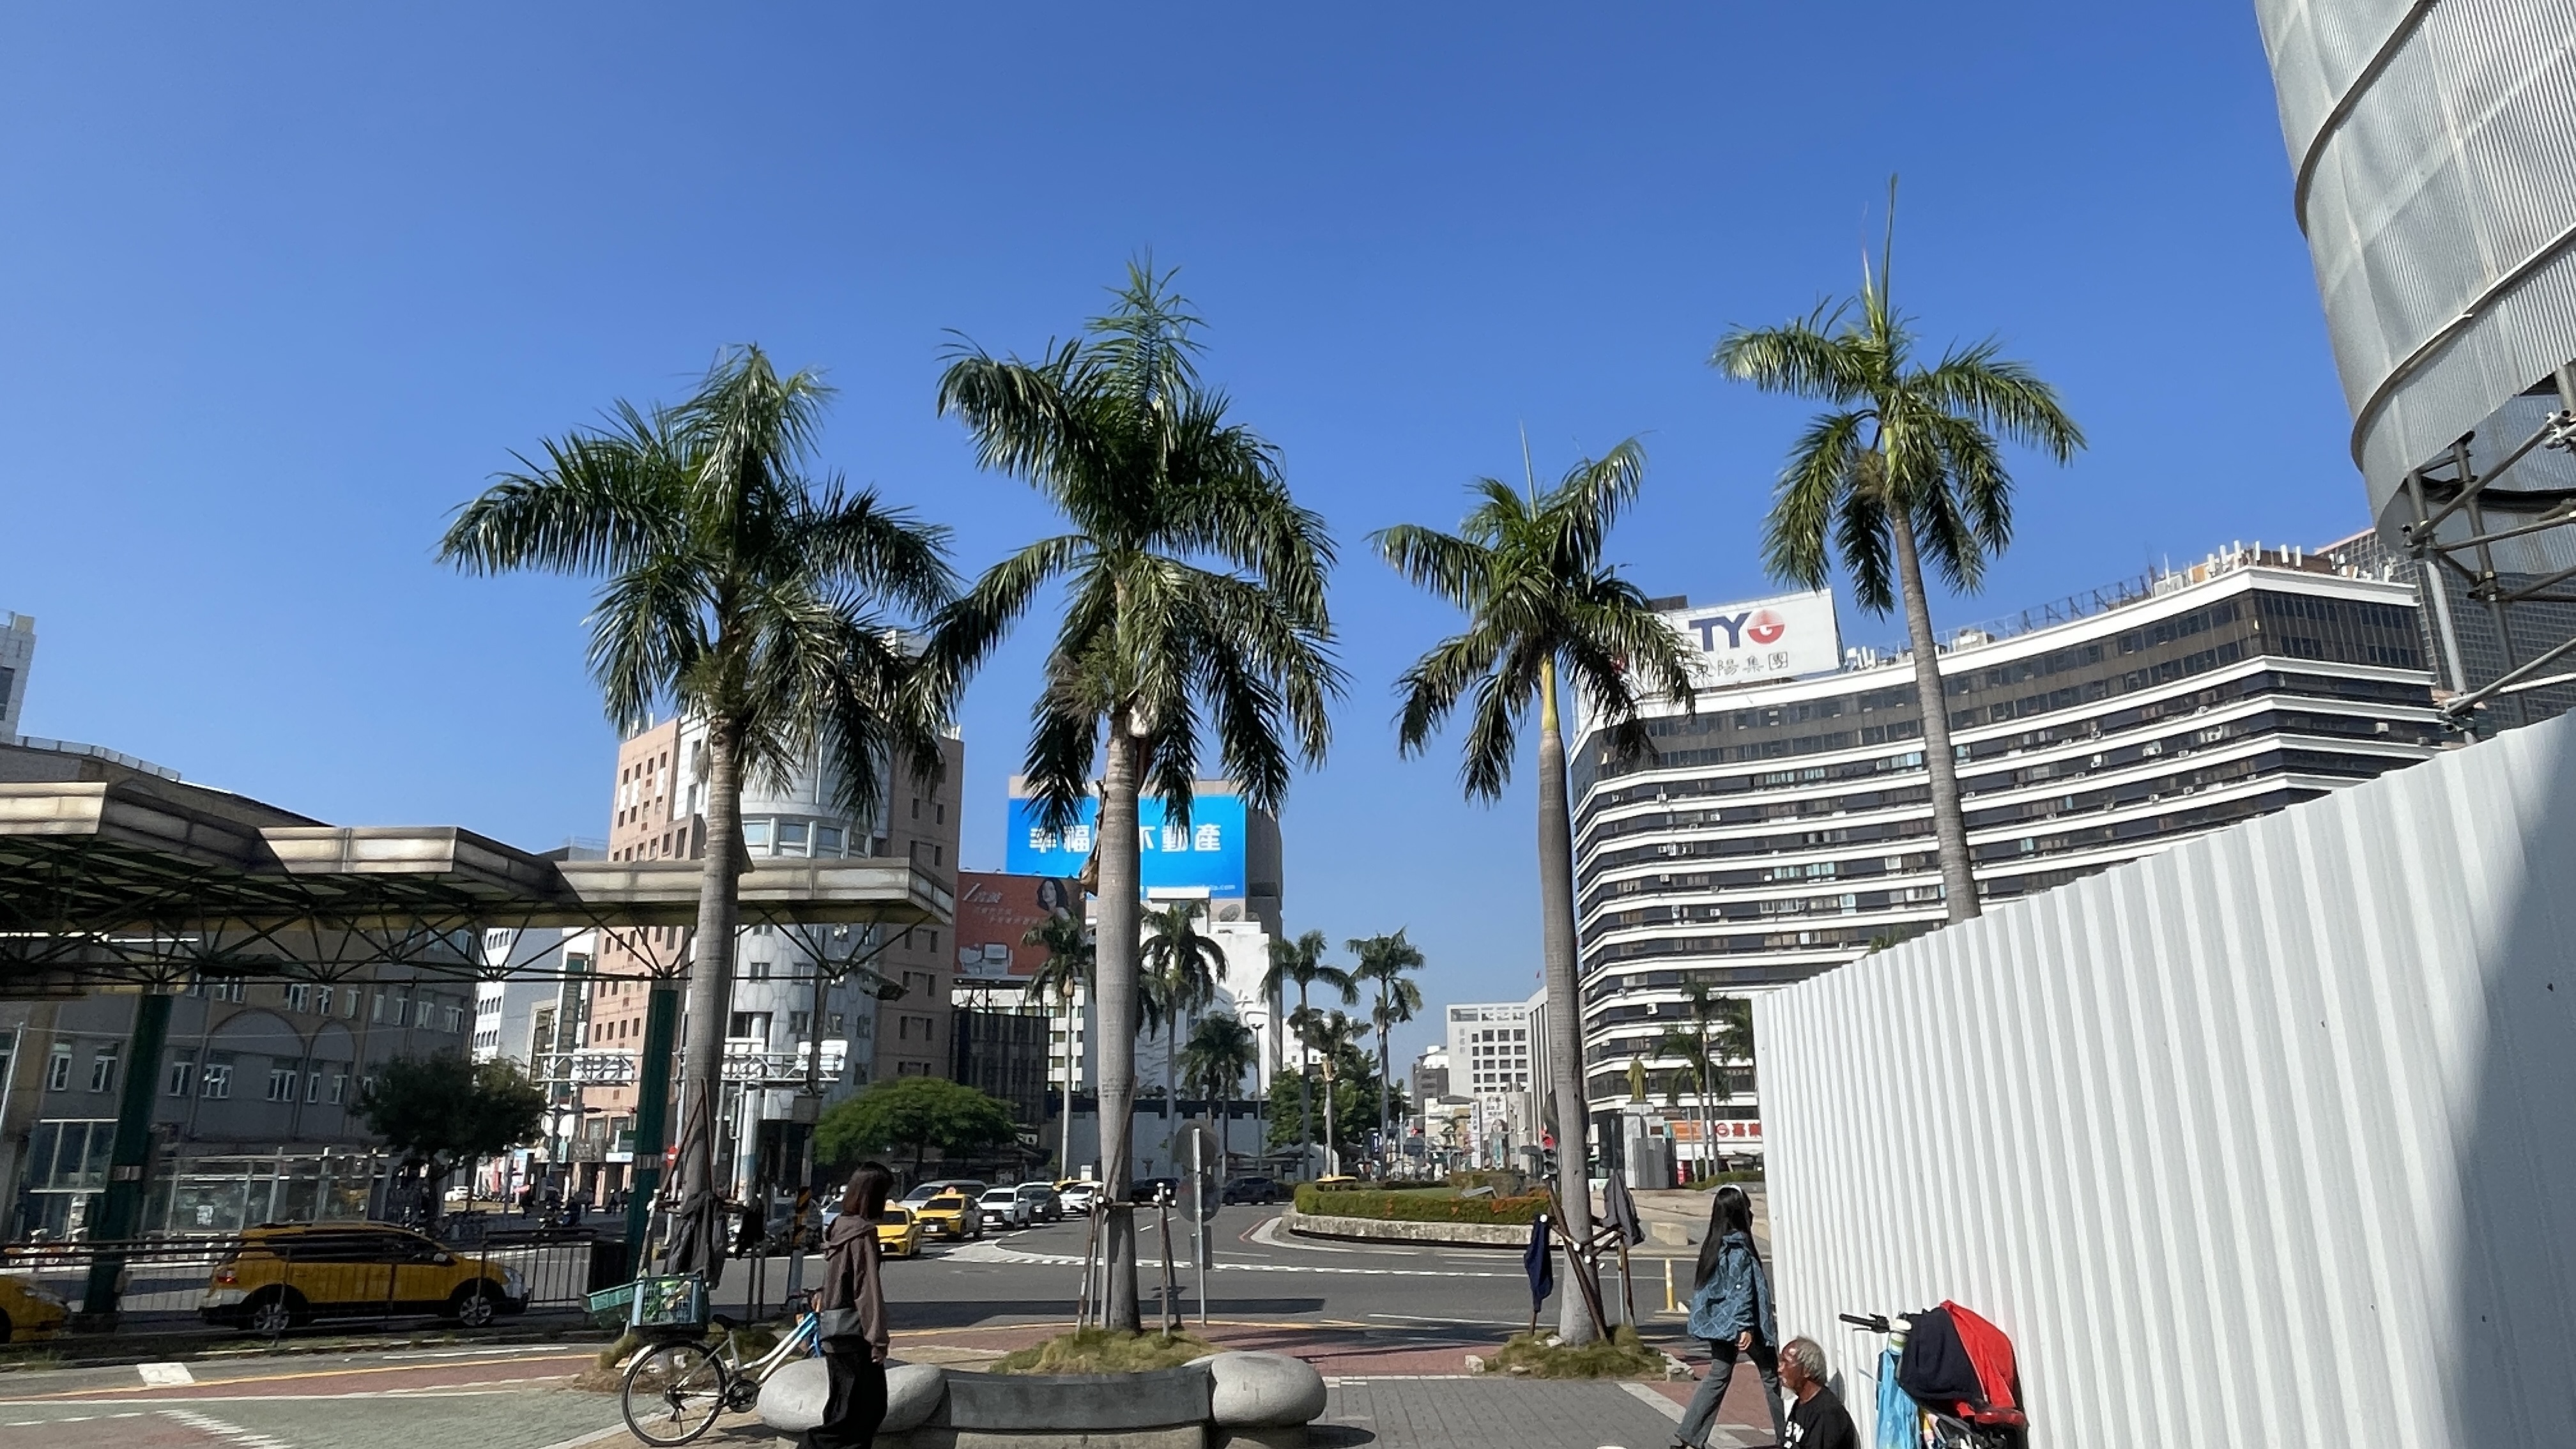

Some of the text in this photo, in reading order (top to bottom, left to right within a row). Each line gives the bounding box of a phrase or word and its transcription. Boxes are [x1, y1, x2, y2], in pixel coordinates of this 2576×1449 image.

[1029, 823, 1221, 853] 幸福不動產
